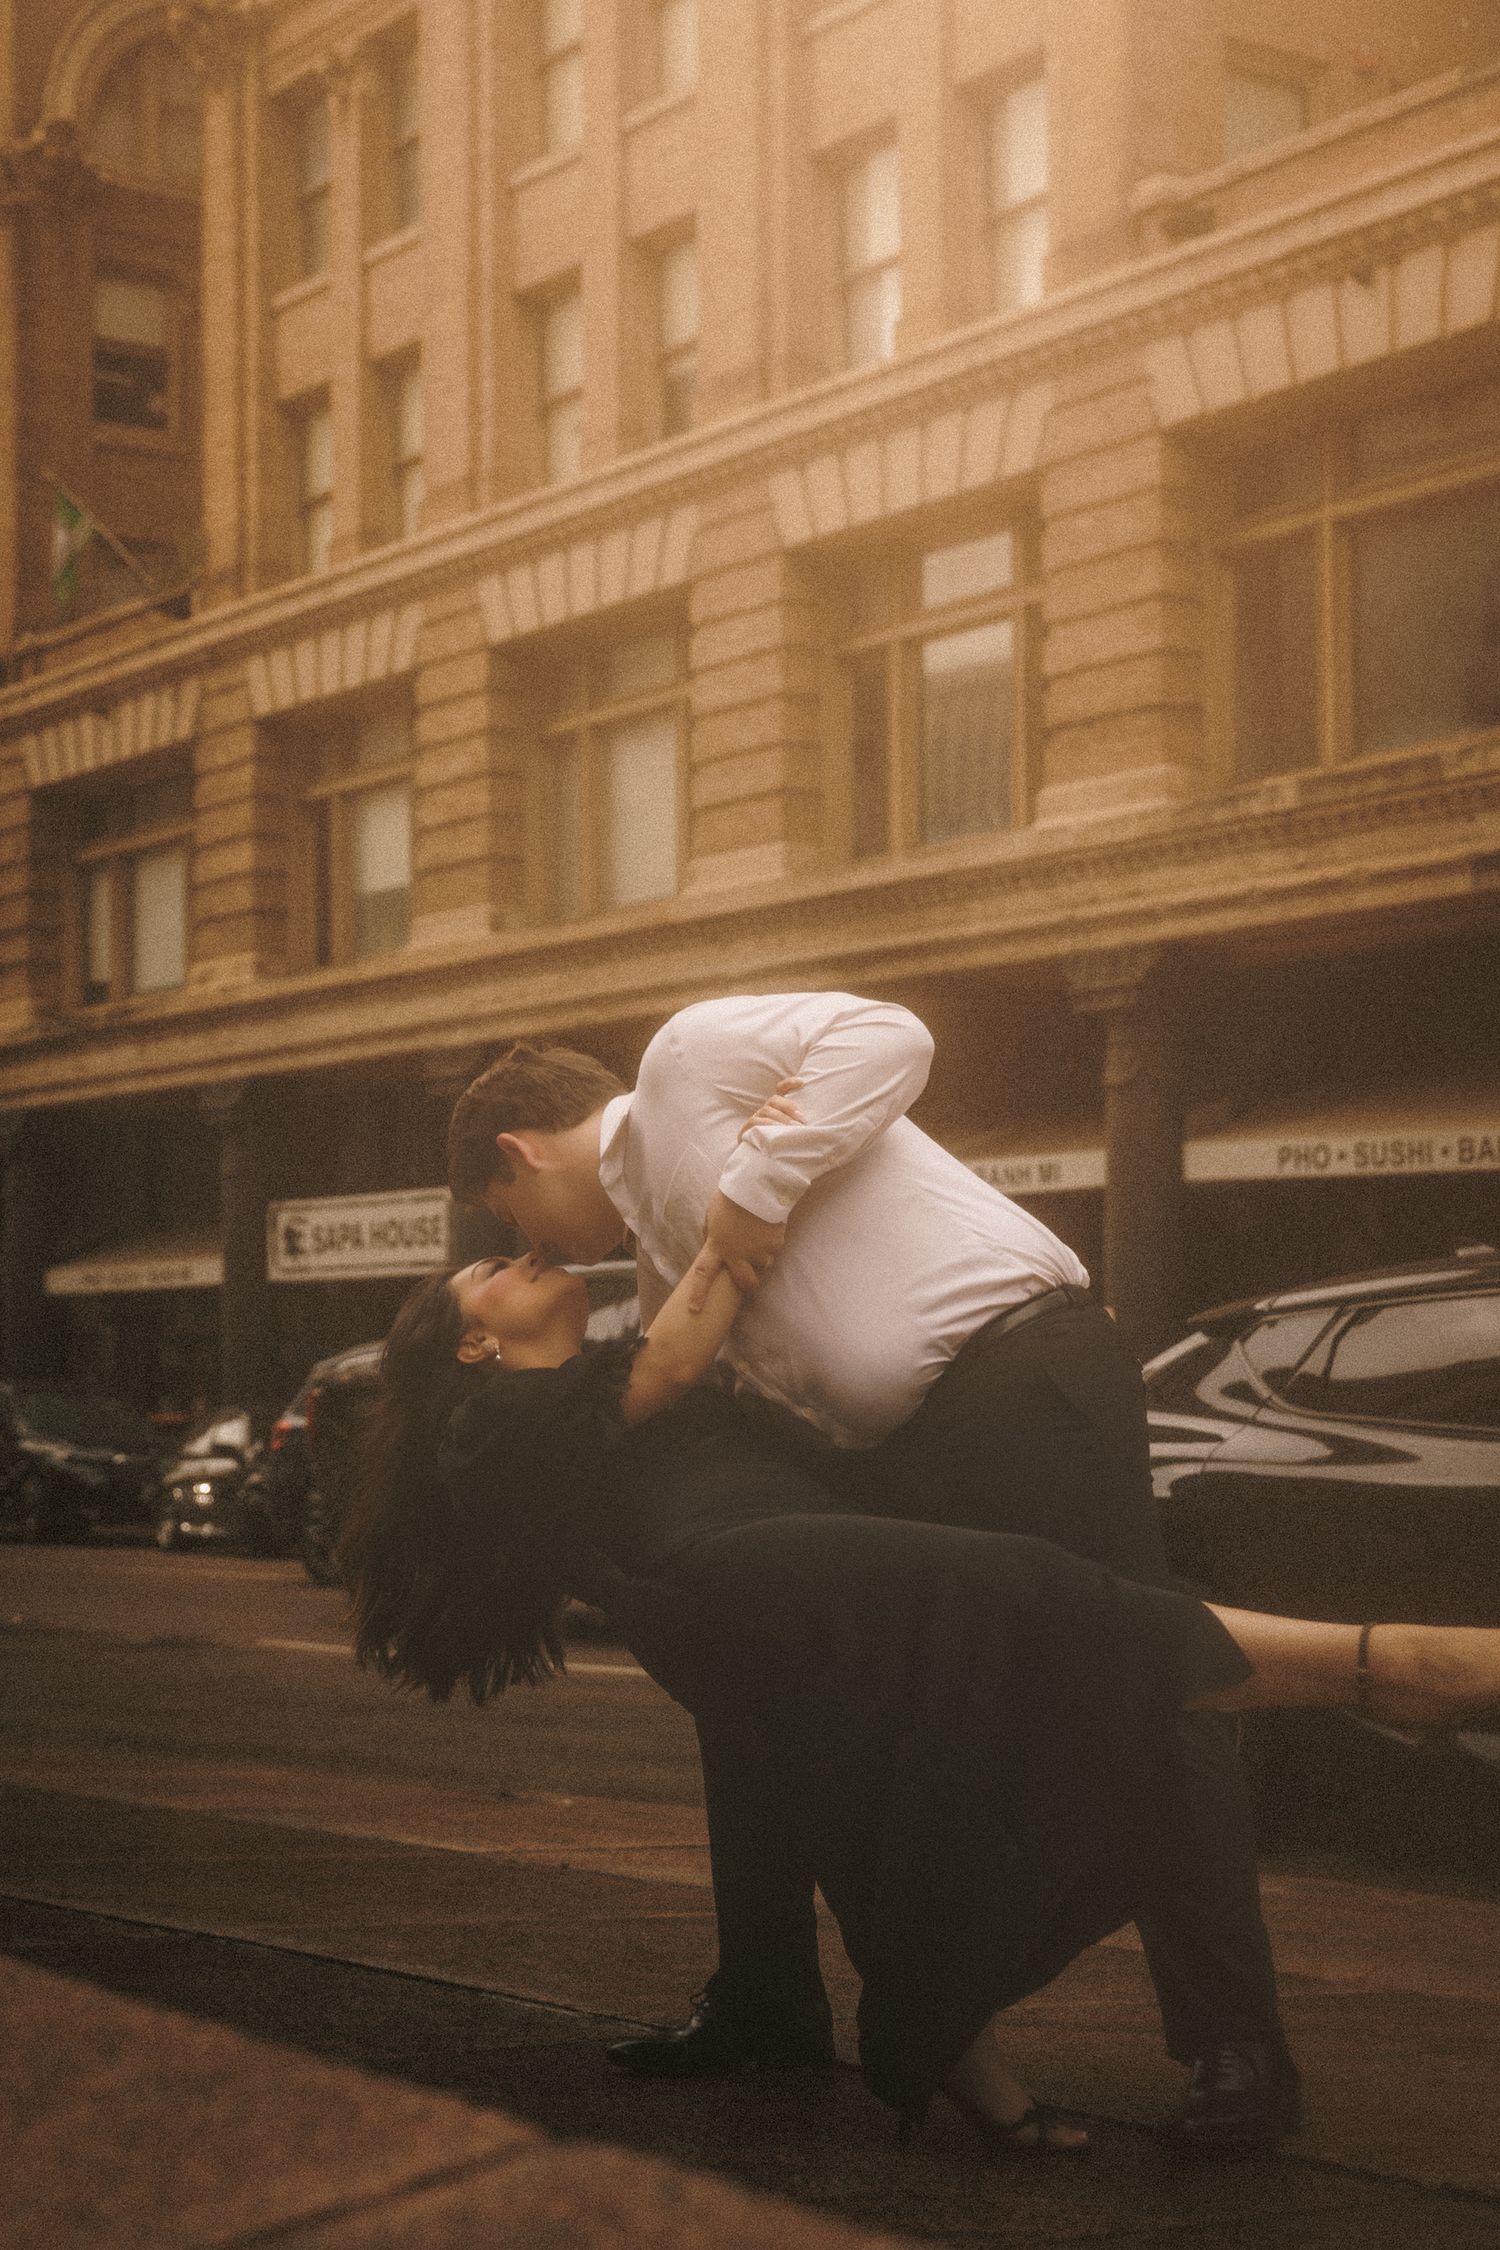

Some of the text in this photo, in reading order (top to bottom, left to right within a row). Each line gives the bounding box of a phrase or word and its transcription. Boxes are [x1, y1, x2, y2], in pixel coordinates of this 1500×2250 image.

[1277, 1133, 1500, 1171] PHO SUSHI BA
[370, 1212, 442, 1250] HOUSE
